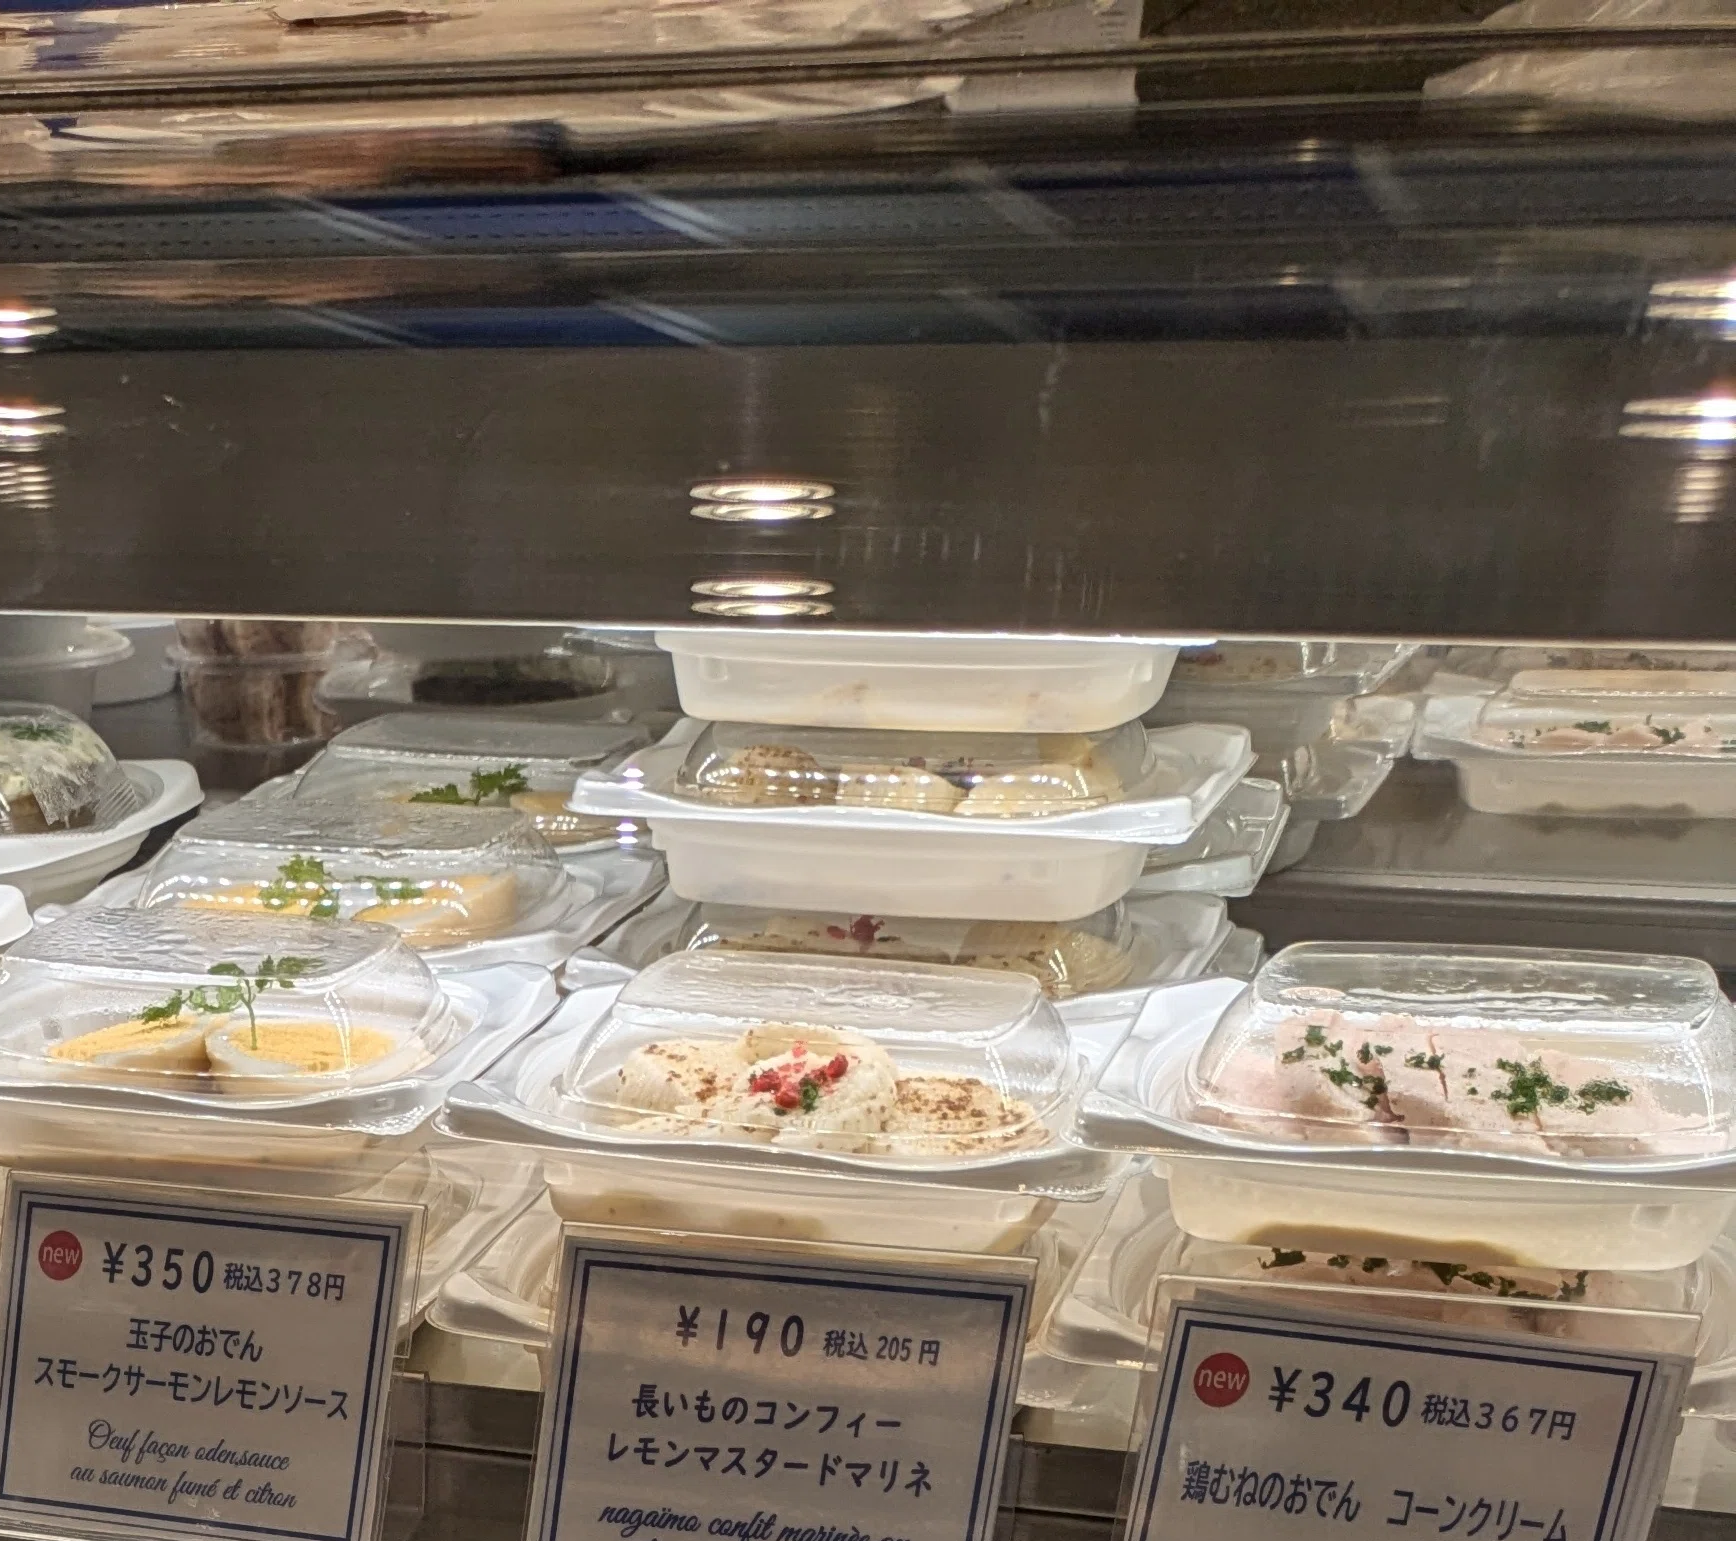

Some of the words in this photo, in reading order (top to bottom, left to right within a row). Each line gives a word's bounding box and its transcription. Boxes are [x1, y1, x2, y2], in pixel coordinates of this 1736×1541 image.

[42, 1244, 80, 1266] new
[102, 1242, 214, 1294] ¥350
[126, 1318, 263, 1363] 玉子のおでん
[676, 1305, 804, 1358] ¥190
[35, 1357, 349, 1421] スモークサーモンレモンソース
[632, 1384, 902, 1439] 長いものコンフィー
[1197, 1368, 1246, 1392] new
[1268, 1366, 1411, 1428] ¥340
[137, 1437, 189, 1466] façon
[607, 1432, 933, 1498] レモンマスタードマリネ
[71, 1467, 94, 1481] au
[99, 1470, 168, 1492] saumon
[170, 1471, 218, 1503] fumé
[223, 1480, 240, 1500] et
[245, 1482, 297, 1509] citron
[599, 1505, 701, 1537] nagaïmo
